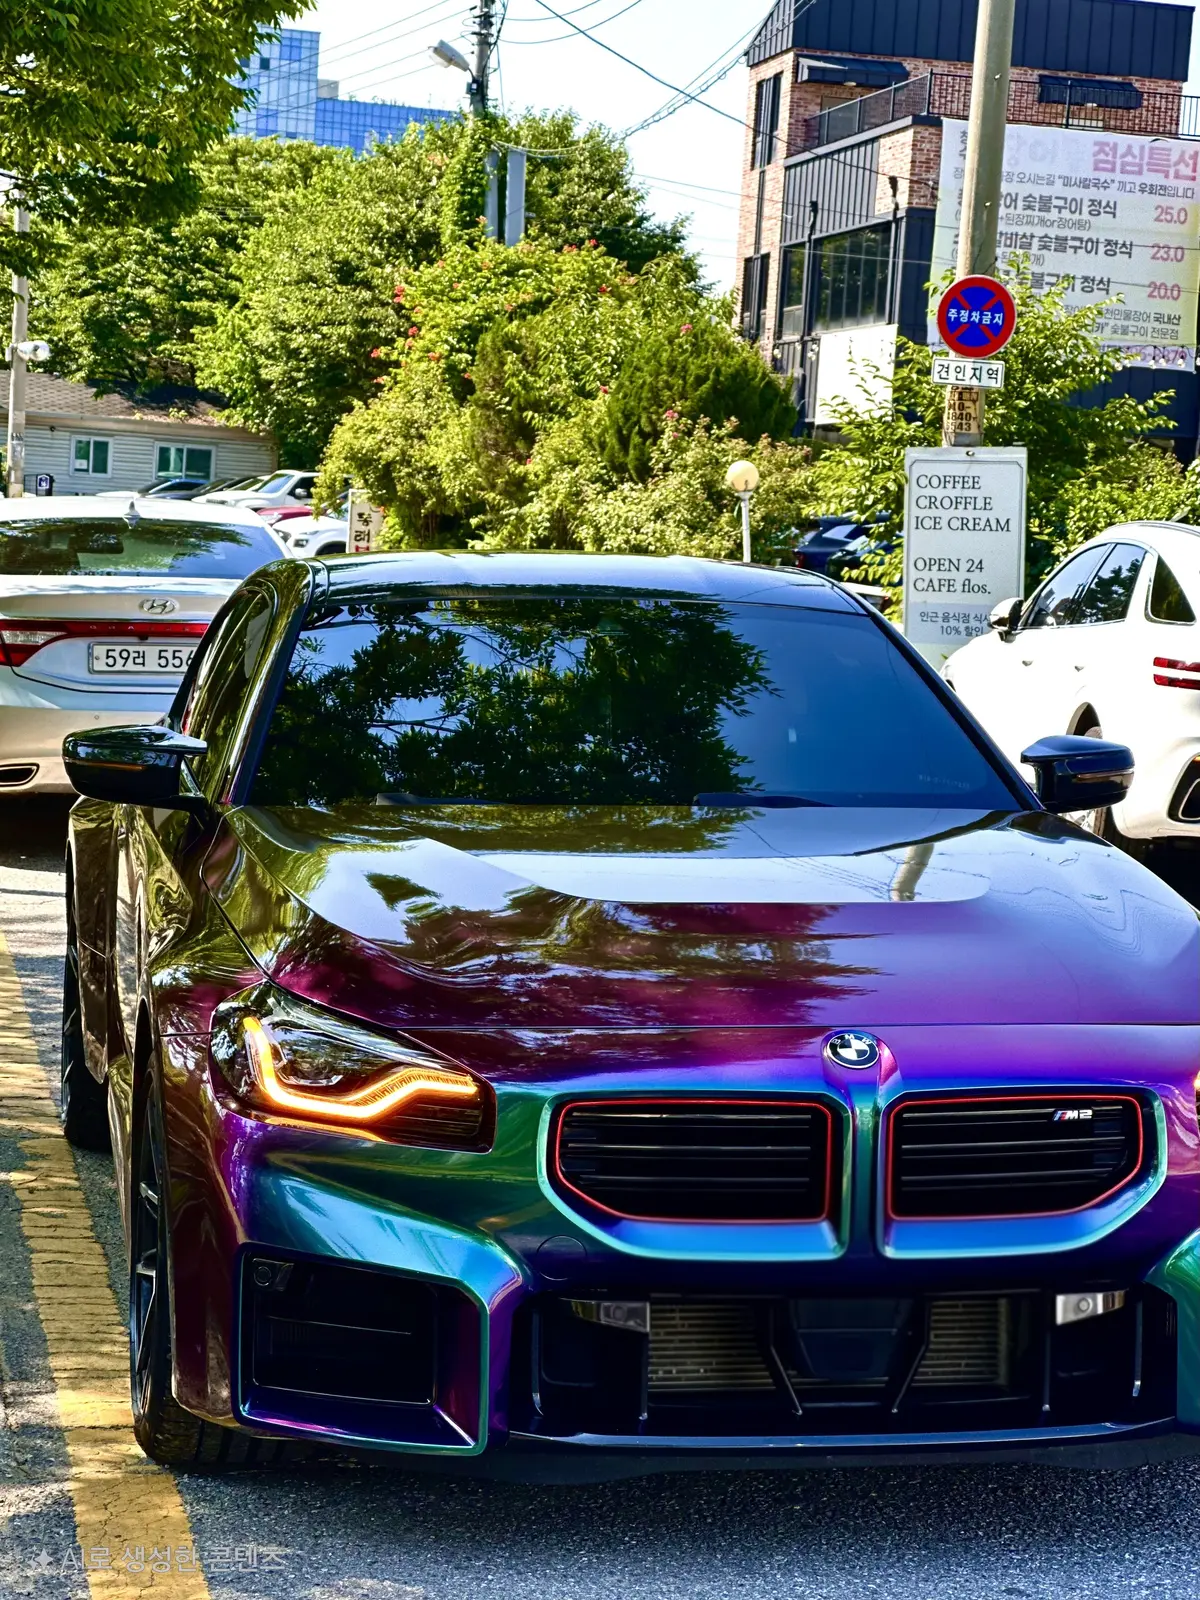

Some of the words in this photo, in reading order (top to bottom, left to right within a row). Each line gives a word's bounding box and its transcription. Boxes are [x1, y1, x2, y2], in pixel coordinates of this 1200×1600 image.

[1093, 139, 1199, 181] 점심특선
[1016, 172, 1055, 186] 오시는길
[1138, 183, 1195, 199] 우회전입니다
[1022, 193, 1083, 216] 숯불구이
[1088, 199, 1117, 218] 정식
[1154, 205, 1188, 225] 25.0
[1037, 233, 1099, 255] 숯불구이
[1103, 239, 1133, 259] 정식
[1150, 243, 1185, 263] 23.0
[1080, 275, 1111, 295] 정식
[1148, 281, 1181, 301] 20.0
[948, 308, 1004, 325] 주정차금지
[1153, 312, 1181, 326] 국내산
[1150, 328, 1179, 340] 전문점
[937, 363, 999, 384] 견인지역
[916, 474, 981, 490] COFFEE
[915, 495, 993, 511] CROFFLE
[914, 516, 942, 531] ICE
[948, 516, 1011, 532] CREAM
[914, 557, 961, 572] OPEN
[966, 558, 985, 573] 24
[913, 578, 957, 592] CAFE
[961, 578, 991, 595] flos.
[920, 611, 939, 622] 인근
[941, 611, 970, 624] 음식점
[940, 625, 961, 636] 10%
[964, 626, 984, 637] 할인
[105, 648, 146, 668] 59러
[1053, 1109, 1093, 1121] M2
